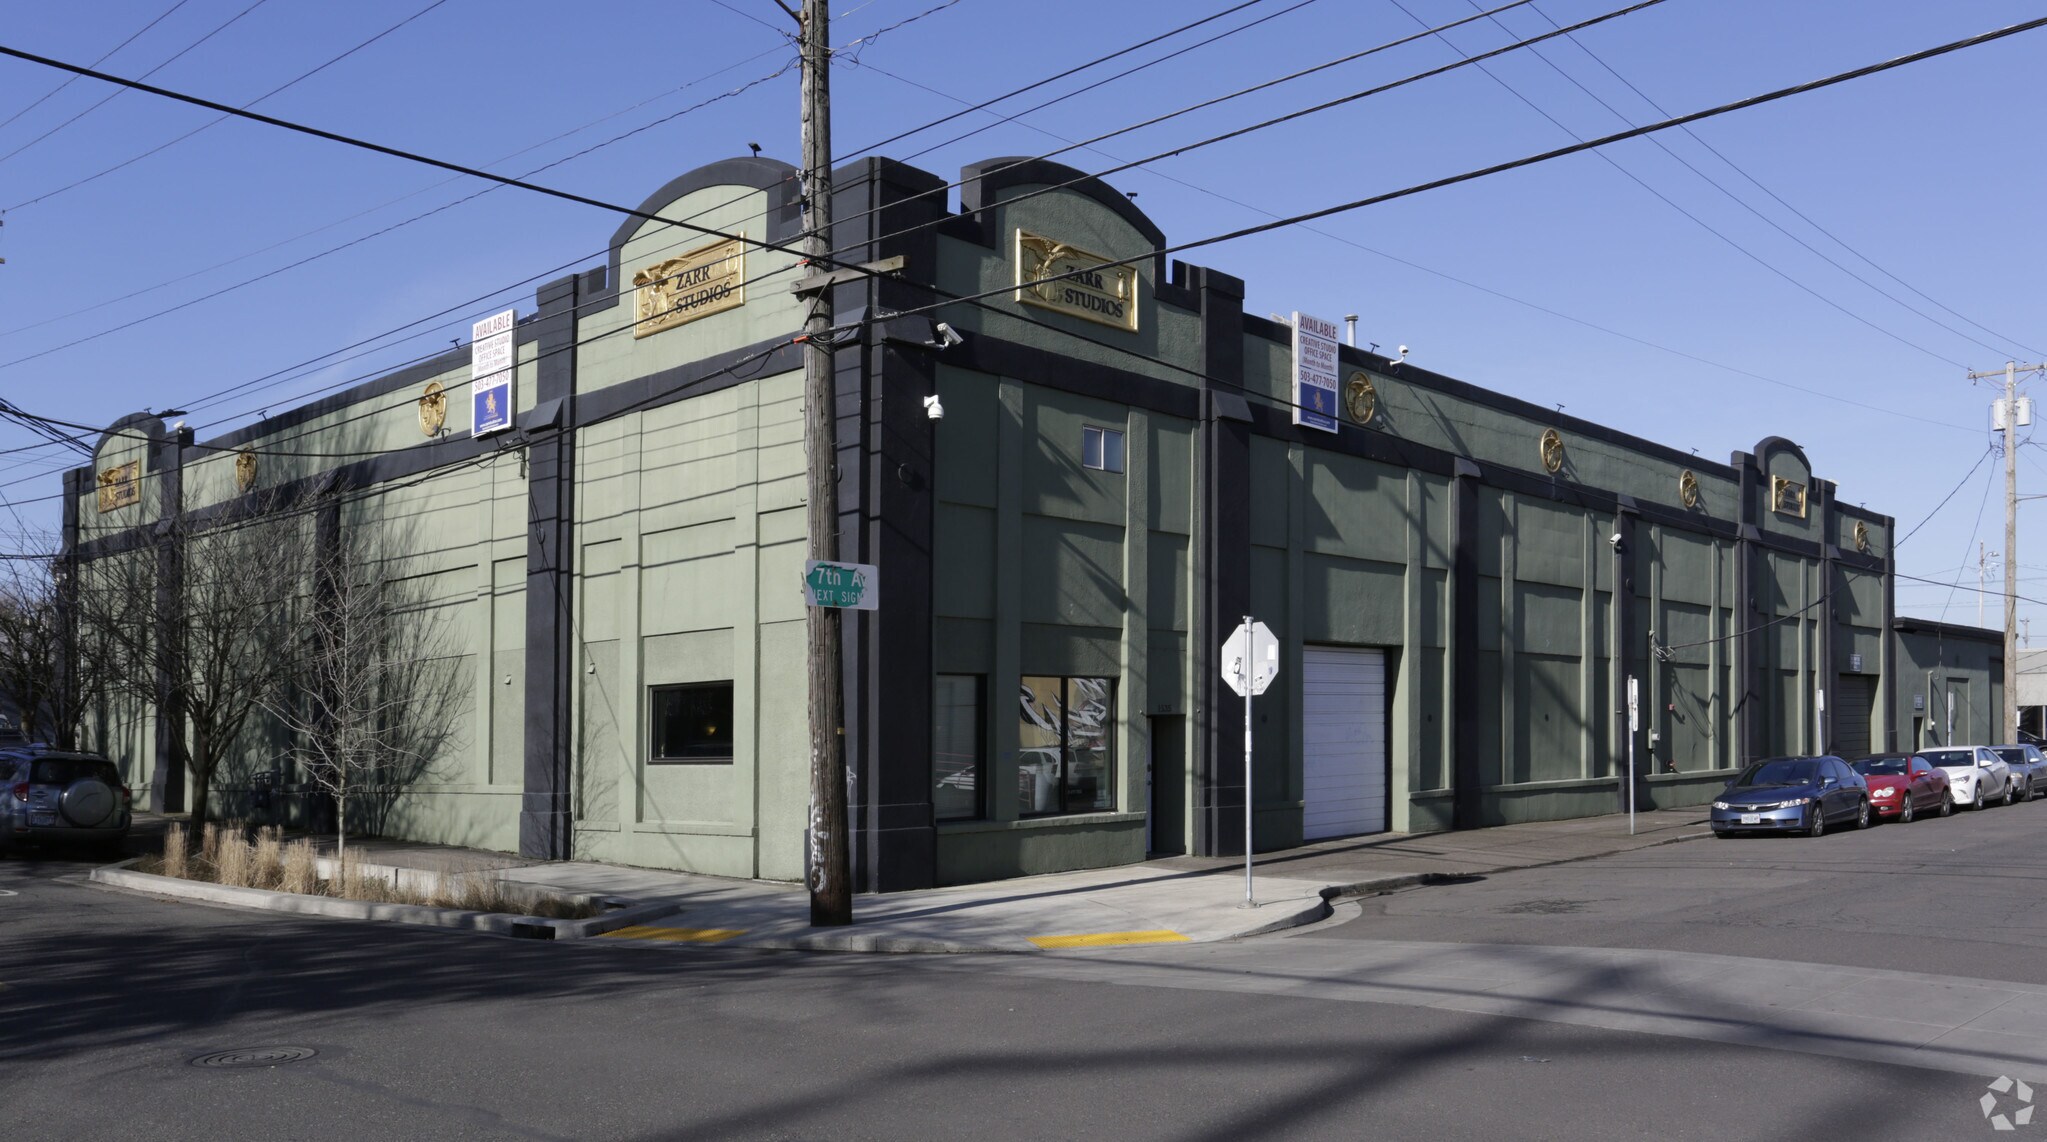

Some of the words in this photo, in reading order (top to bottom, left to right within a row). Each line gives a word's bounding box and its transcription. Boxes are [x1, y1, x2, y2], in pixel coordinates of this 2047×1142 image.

[675, 266, 711, 290] ZARR
[1065, 265, 1104, 290] ZARR
[675, 281, 731, 314] STUDIOS
[1065, 288, 1124, 318] STUDIOS
[475, 313, 510, 339] AVAILABLE
[1300, 315, 1336, 340] AVAILABLE
[1300, 335, 1320, 350] CREATIVE
[1304, 346, 1318, 358] OFFICE
[1319, 350, 1332, 362] SPACE
[1300, 370, 1337, 390] 503-477-7050
[815, 567, 841, 586] 7th
